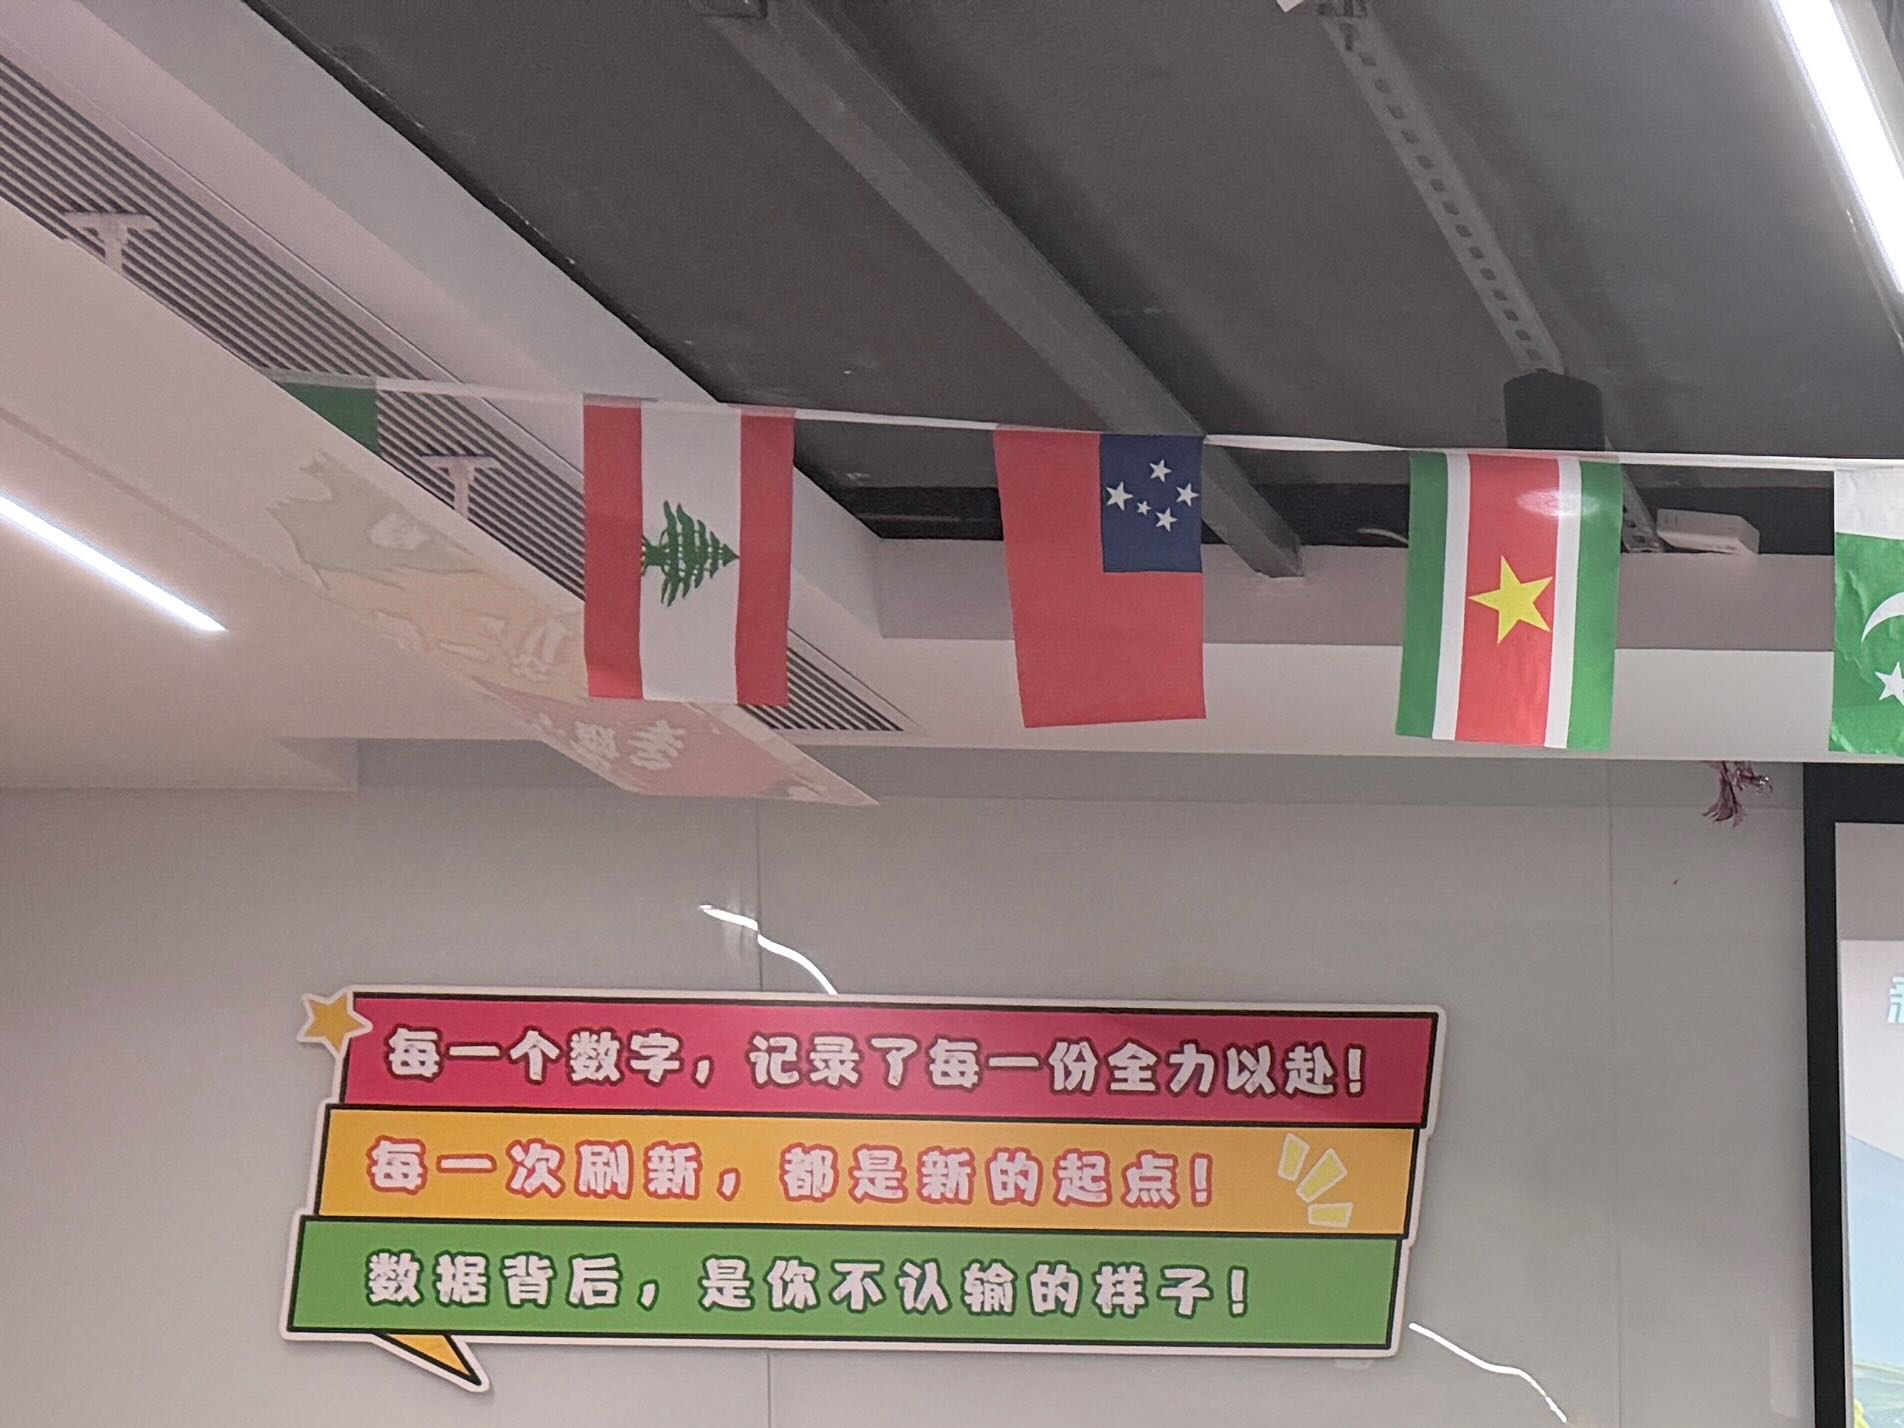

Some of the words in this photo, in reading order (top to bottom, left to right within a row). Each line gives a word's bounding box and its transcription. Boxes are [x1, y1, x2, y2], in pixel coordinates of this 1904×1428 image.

[385, 1028, 1365, 1094] 每一个数字，记录了每一份全力以赴！
[367, 1138, 1214, 1209] 每一次刷新，都是新的起点！
[367, 1250, 1248, 1318] 数据背后，是你不认输的样子！
